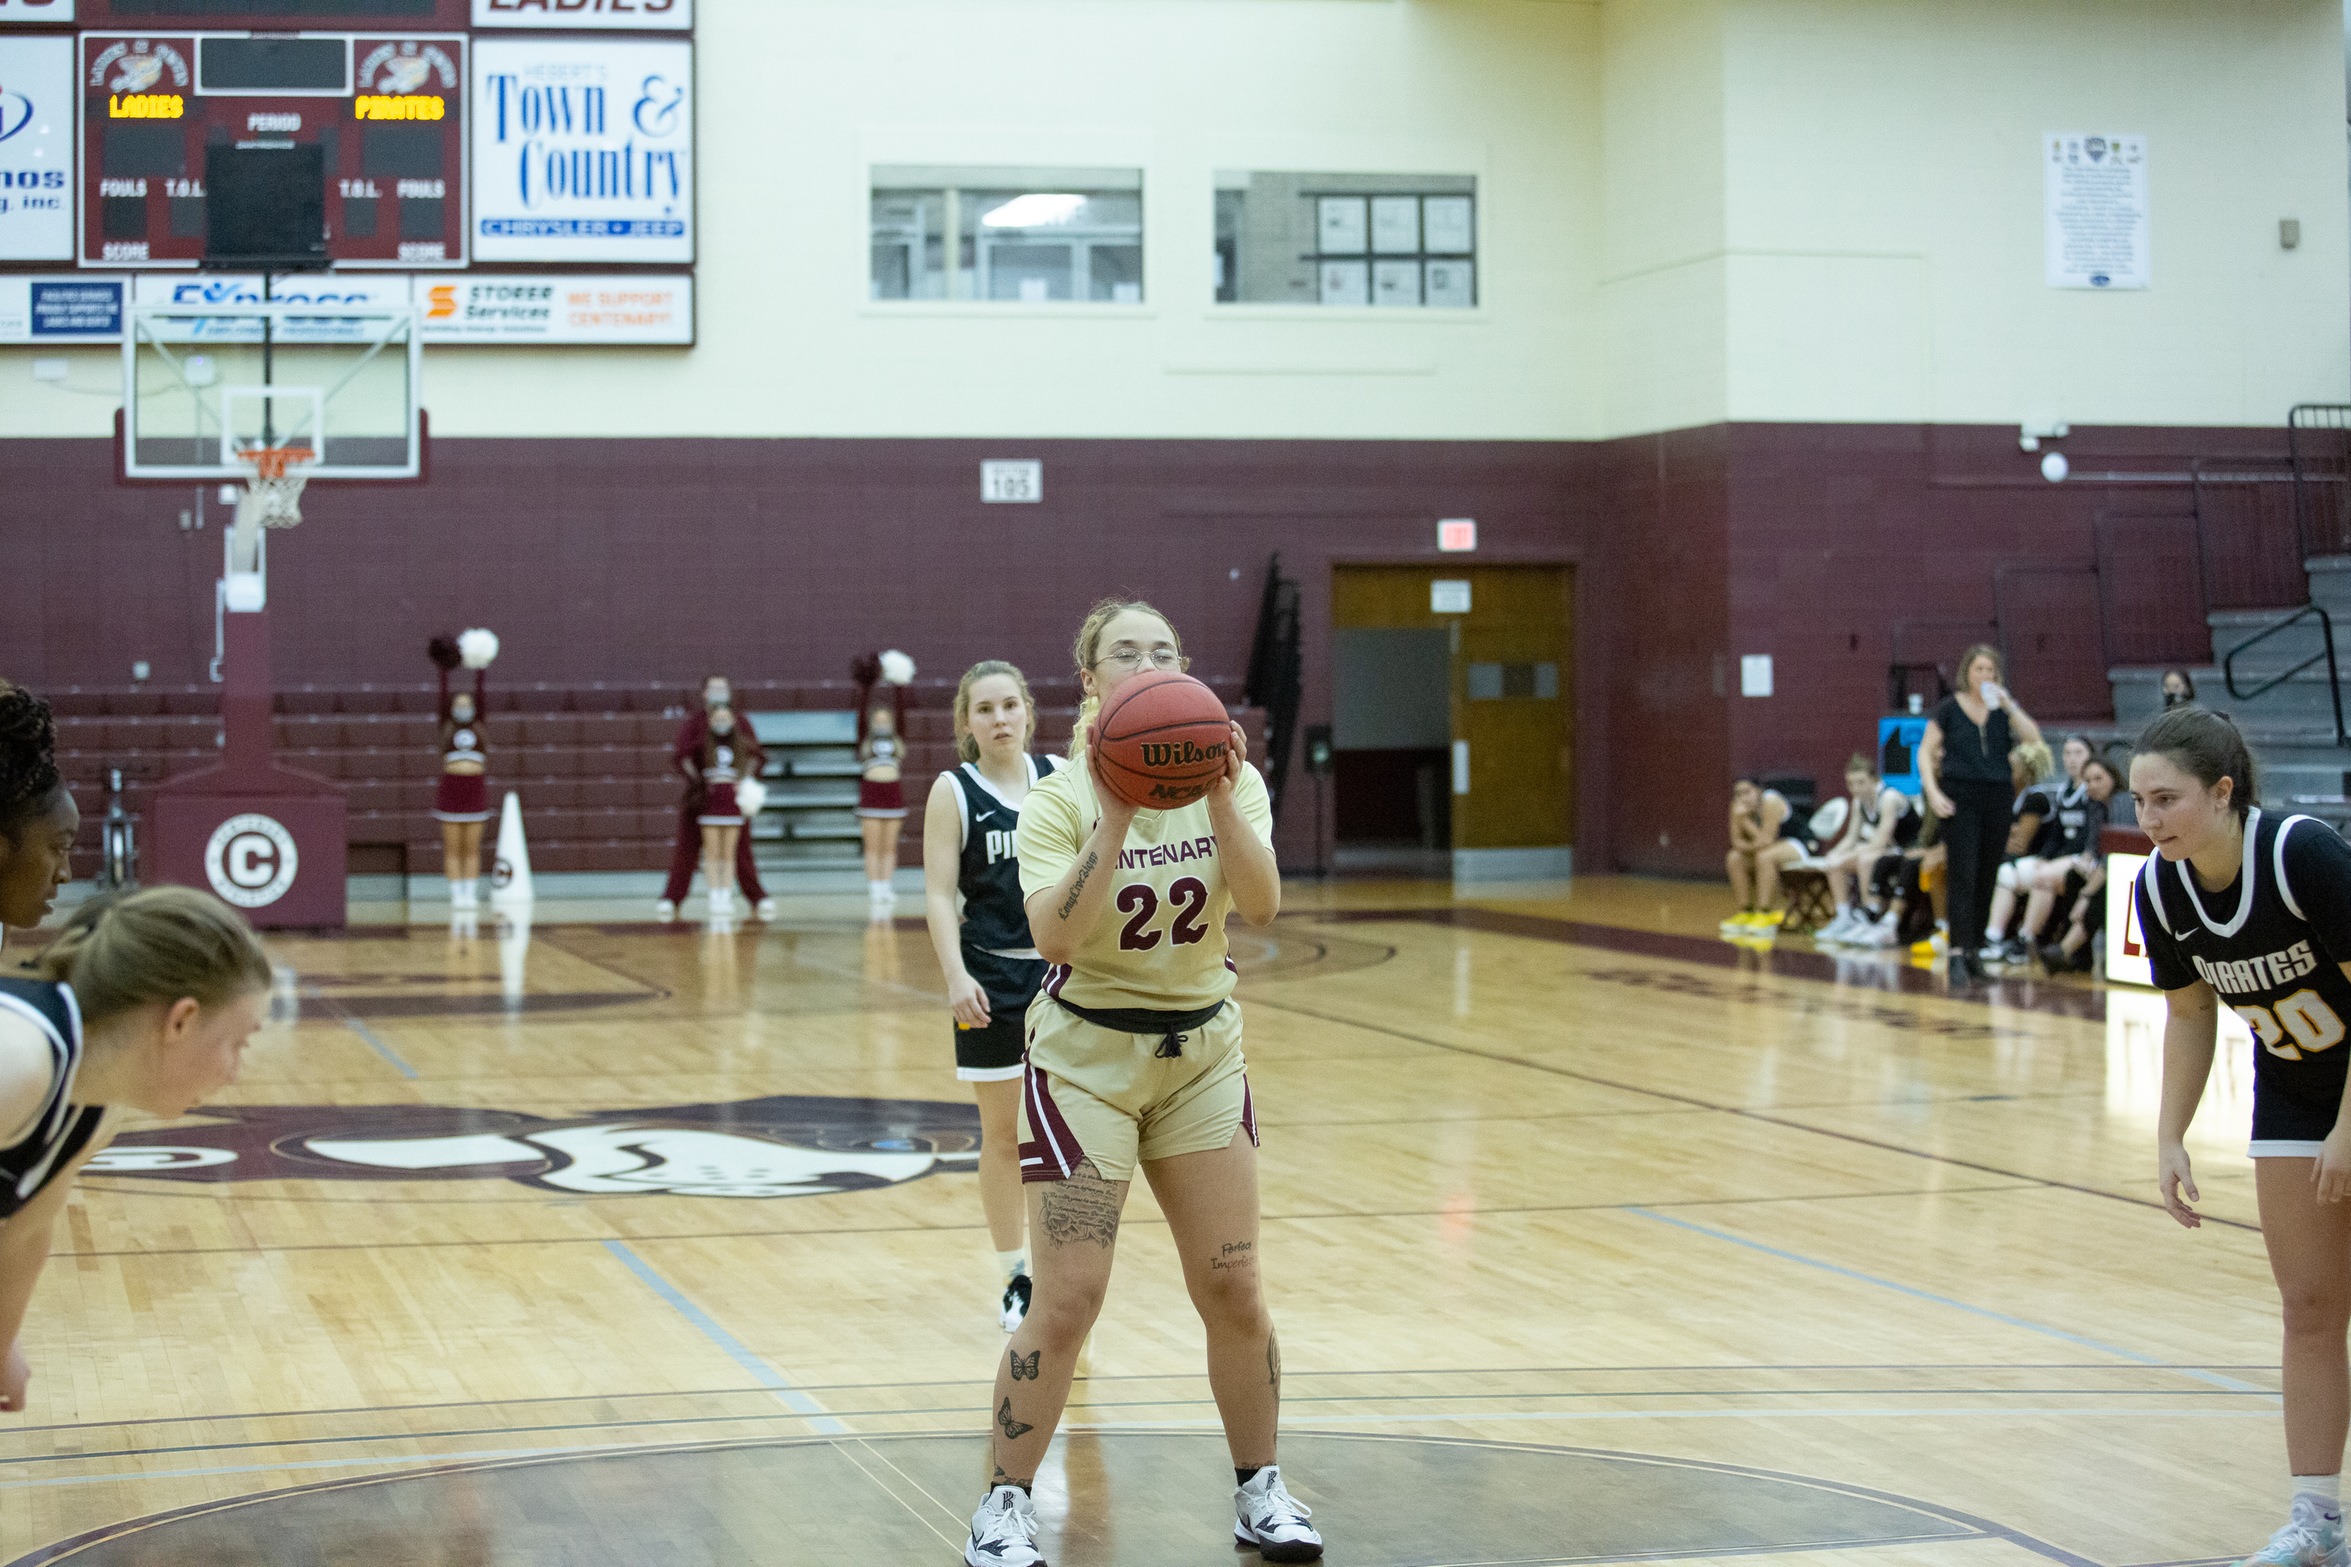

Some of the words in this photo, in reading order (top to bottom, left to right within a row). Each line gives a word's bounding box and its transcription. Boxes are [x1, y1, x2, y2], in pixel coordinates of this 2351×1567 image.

[109, 94, 184, 118] LADIES
[247, 111, 302, 132] PERIOD
[487, 74, 606, 142] Town
[632, 74, 684, 139] &
[99, 178, 148, 198] FOULS
[396, 179, 446, 199] FOULS
[518, 137, 687, 215] Country
[1141, 740, 1227, 767] Wilson
[1115, 876, 1209, 953] 22
[2192, 939, 2318, 994] PIRATES
[2233, 989, 2346, 1061] 20
